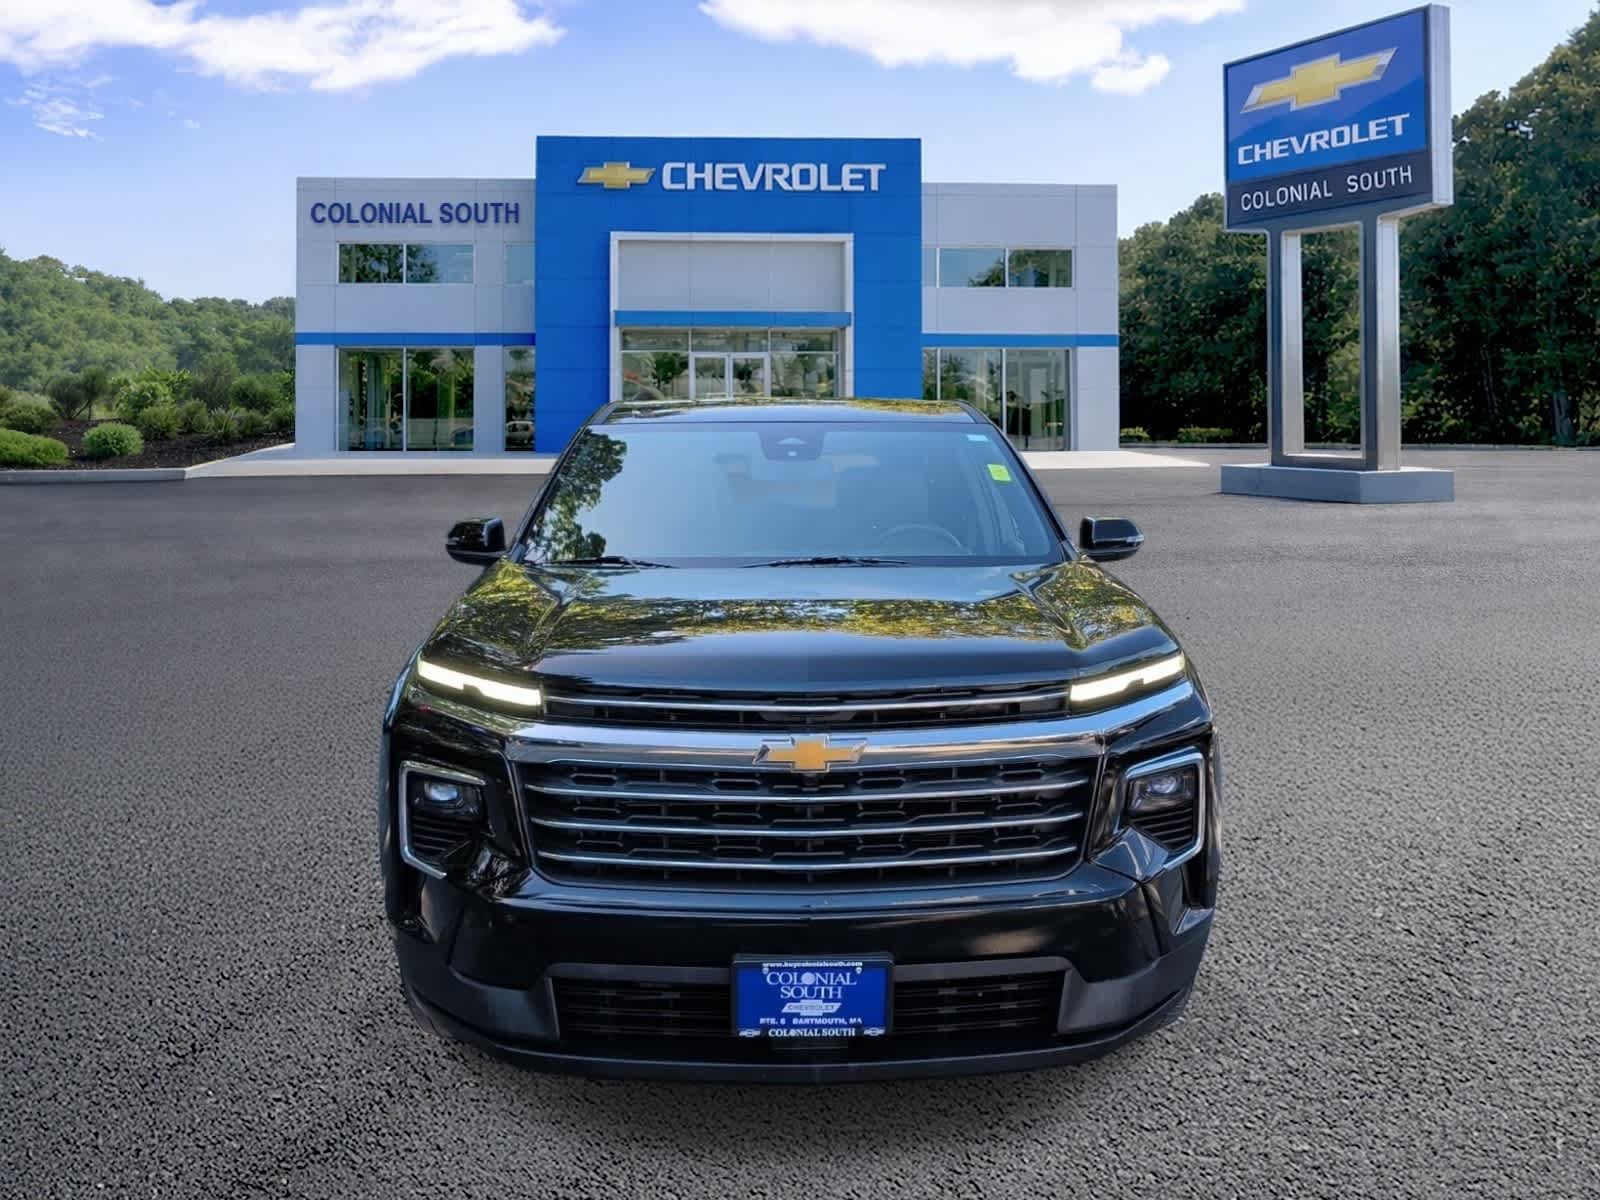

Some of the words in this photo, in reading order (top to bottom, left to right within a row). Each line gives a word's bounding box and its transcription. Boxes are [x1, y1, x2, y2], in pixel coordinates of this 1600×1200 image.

[1238, 113, 1410, 165] CHEVROLET
[662, 162, 886, 193] CHEVROLET
[1240, 179, 1333, 211] COLONIAL
[1347, 165, 1412, 193] SOUTH
[310, 202, 433, 224] COLONIAL
[439, 202, 520, 224] SOUTH
[766, 972, 857, 986] COLONIAL
[780, 985, 843, 999] SOUTH
[768, 1028, 821, 1037] COLONIAL
[822, 1027, 856, 1037] SOUTH
